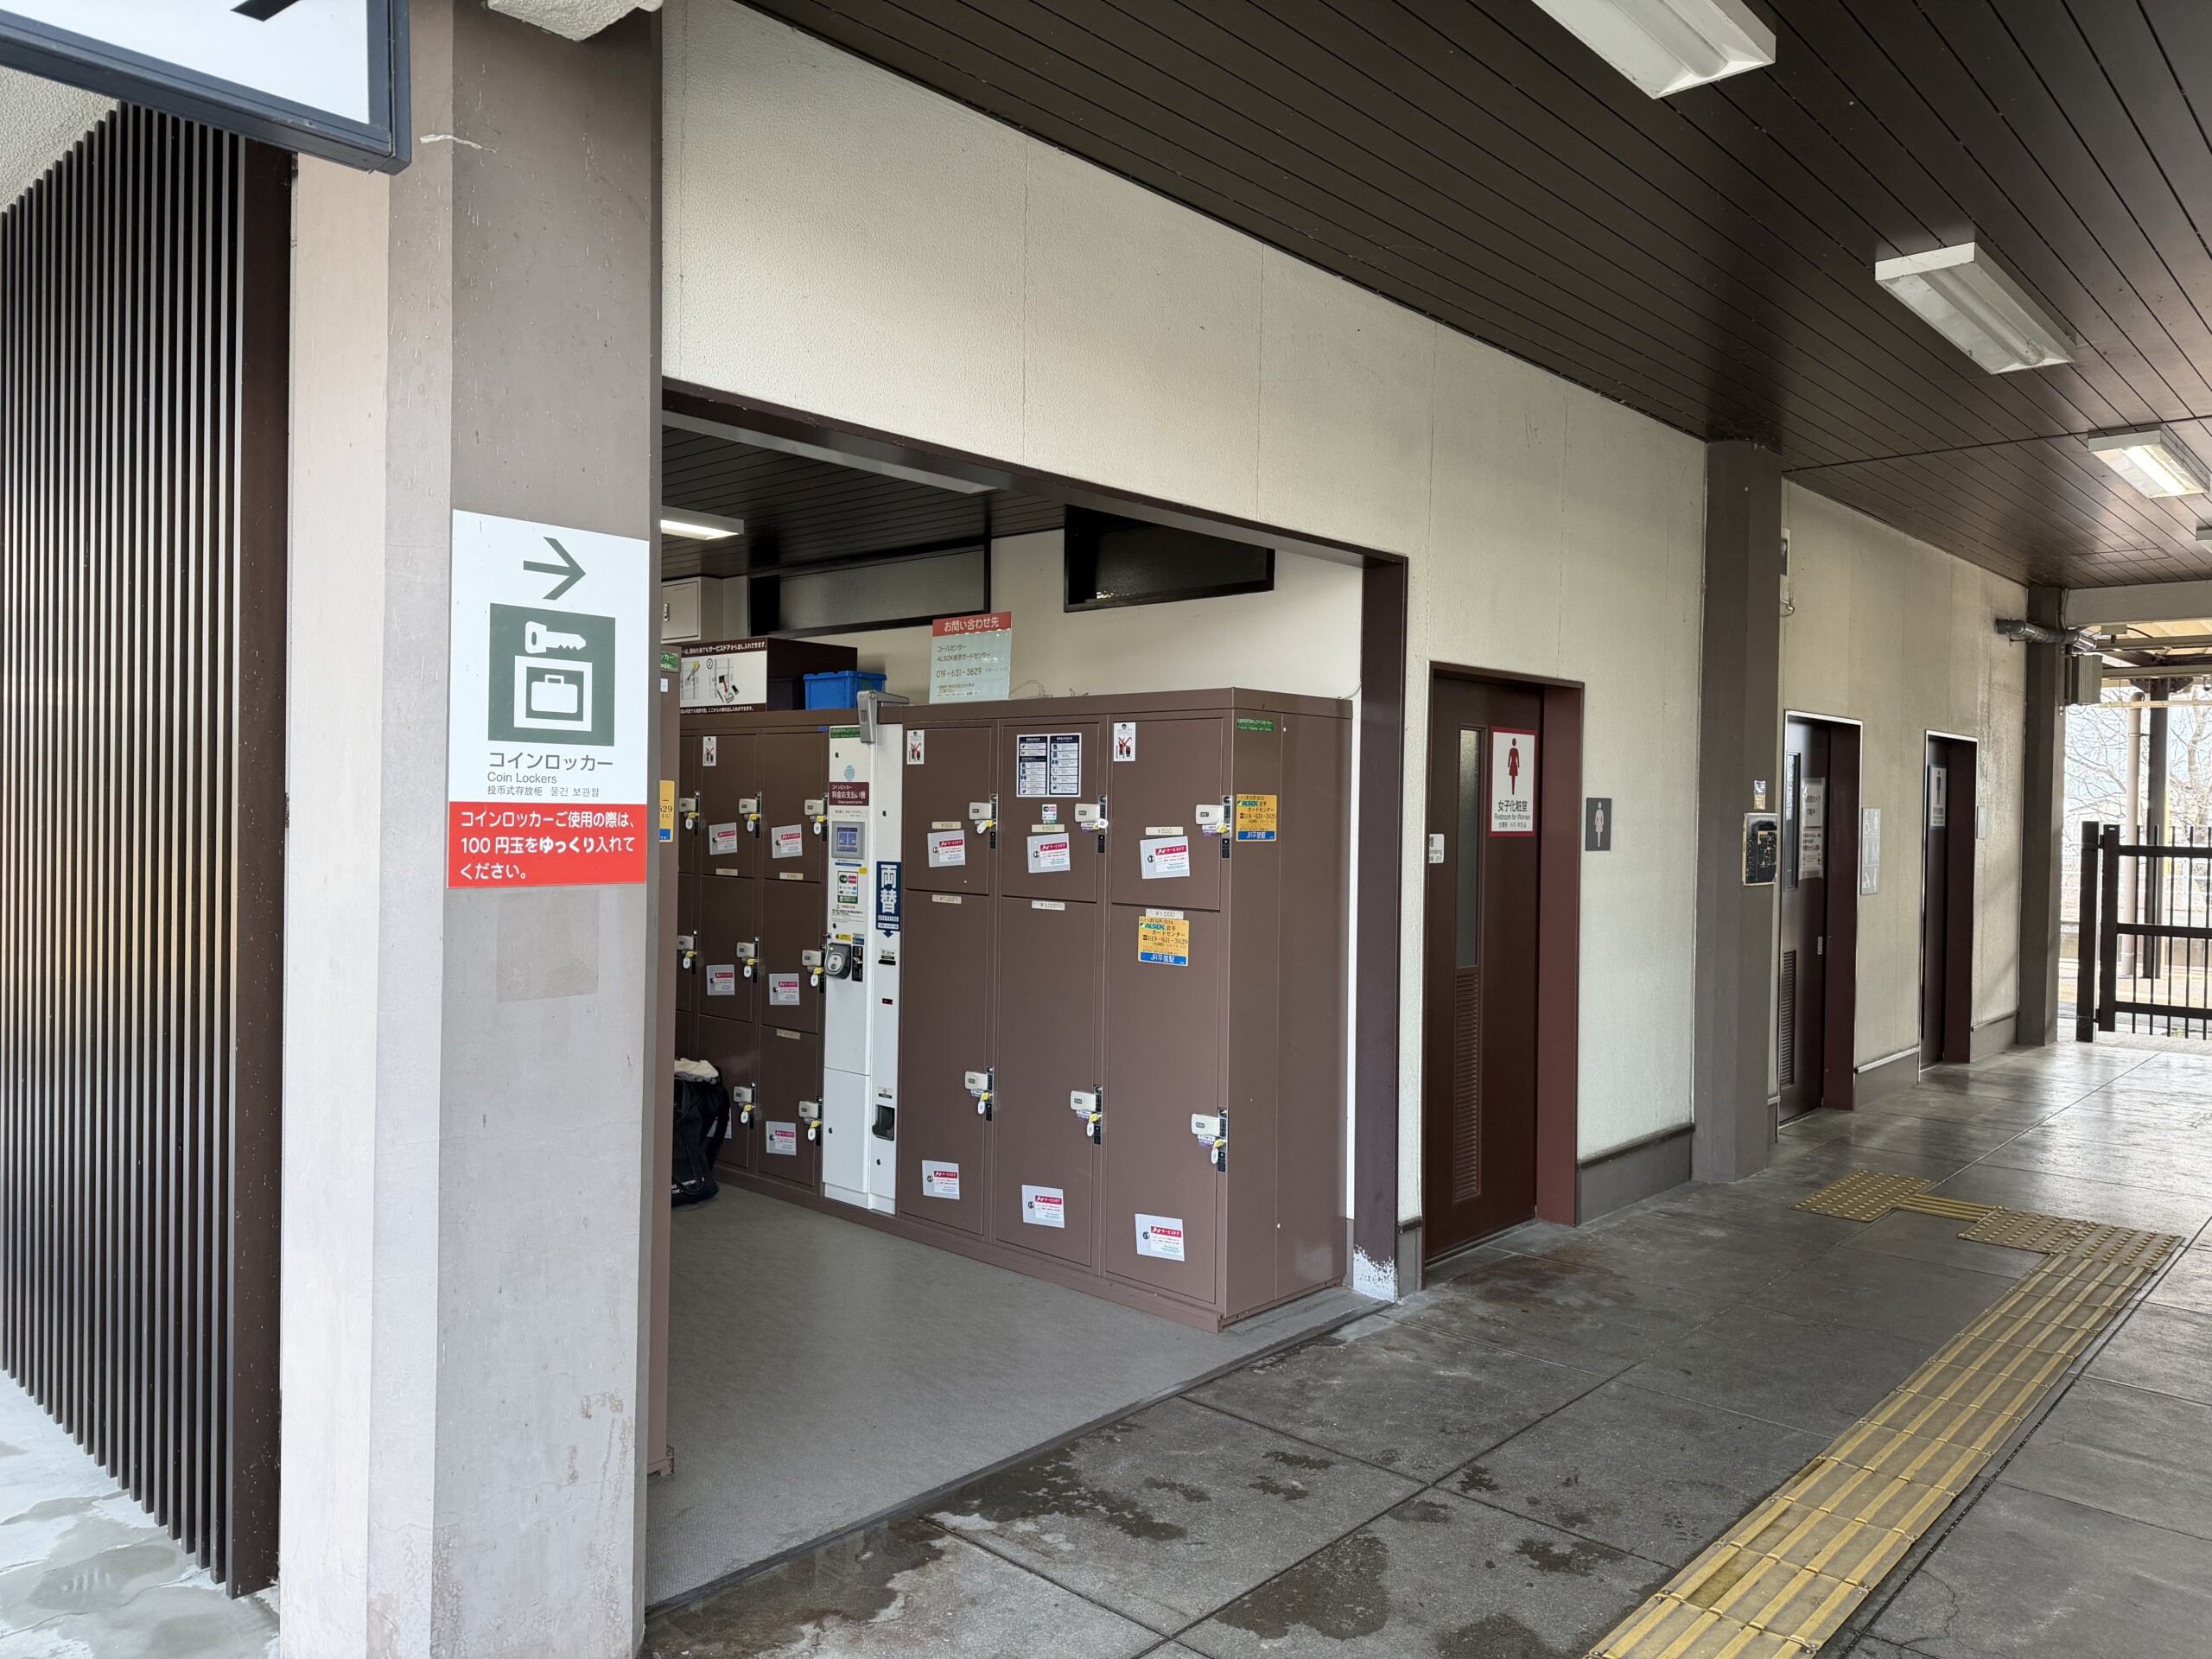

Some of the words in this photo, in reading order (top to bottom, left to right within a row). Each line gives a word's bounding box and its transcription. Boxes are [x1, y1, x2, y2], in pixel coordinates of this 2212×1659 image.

[944, 616, 999, 632] お問い合わせ先
[489, 752, 613, 772] コインロッカー
[487, 771, 512, 783] Coin
[516, 772, 557, 784] Lockers
[487, 785, 543, 797] 投币式存放柜
[550, 786, 569, 798] 물건
[572, 787, 600, 798] 보관함
[831, 791, 866, 799] 料金お支払い機
[1497, 800, 1528, 812] 女子化粧室
[461, 810, 635, 830] コインロッカーご使用の際は、
[460, 861, 527, 880] ください。
[880, 864, 898, 914] 両替
[1147, 935, 1188, 945] 019-631-3629
[1150, 953, 1175, 963] JR平泉駅
